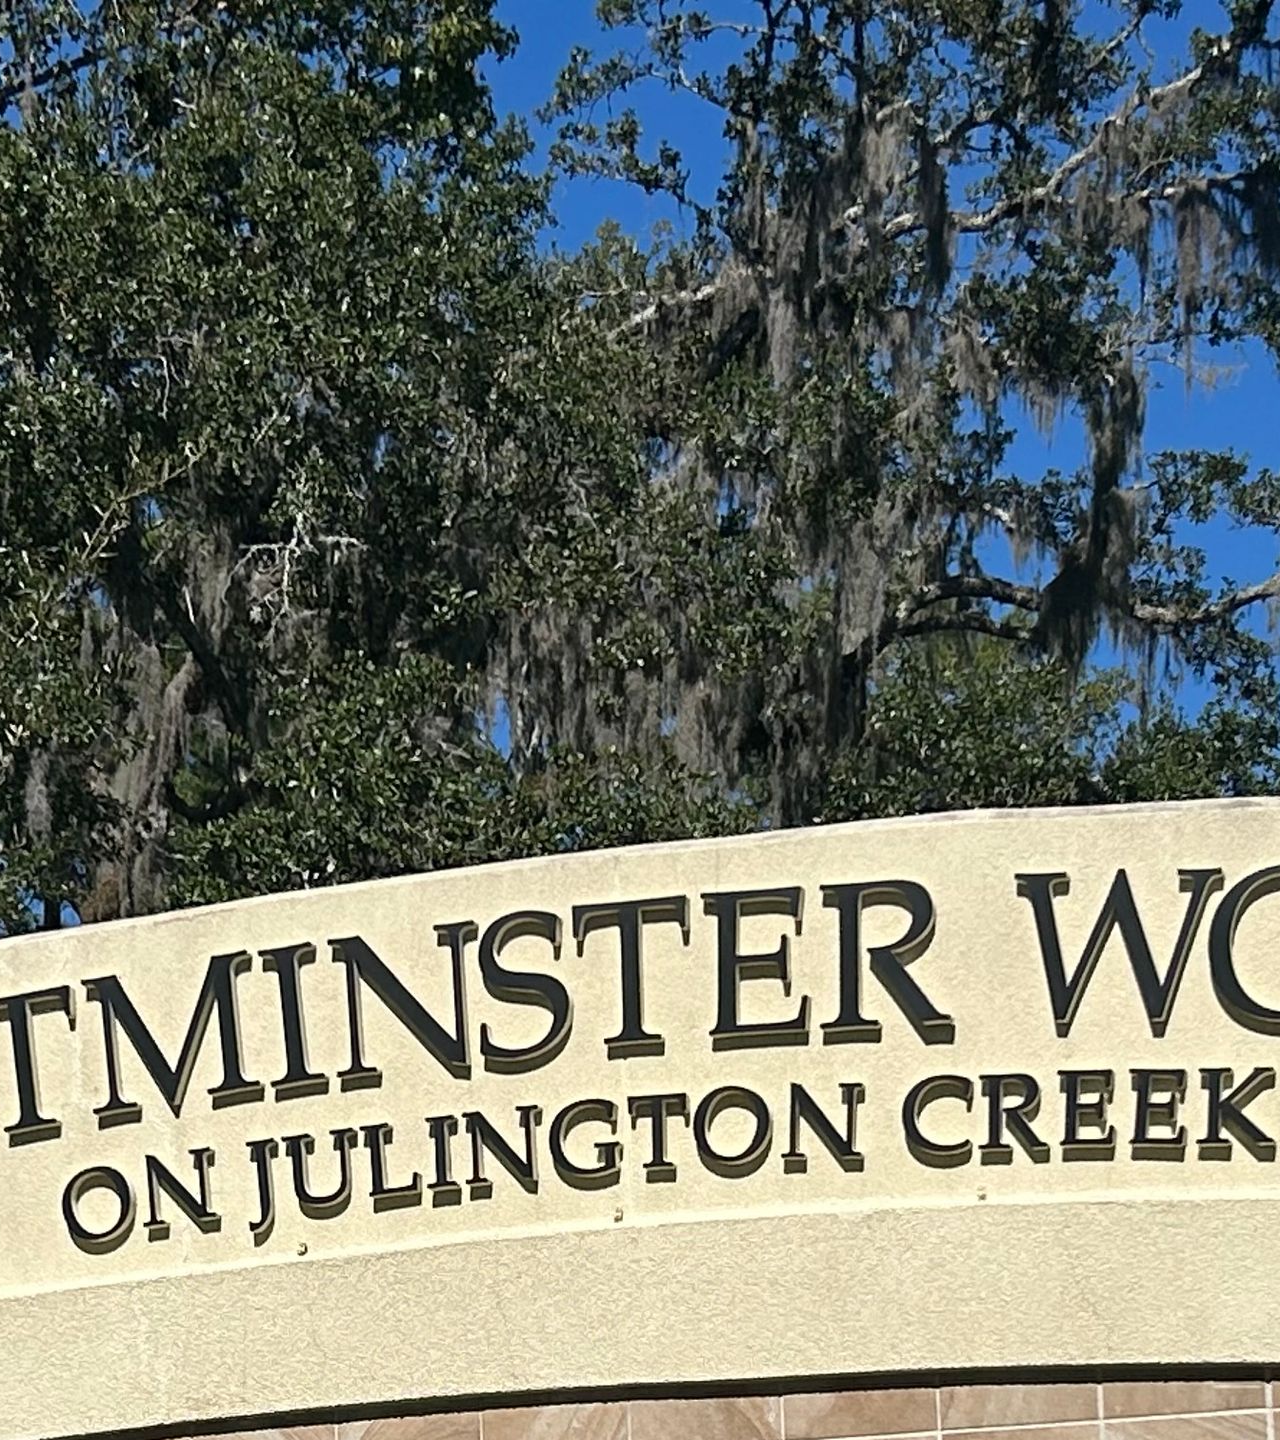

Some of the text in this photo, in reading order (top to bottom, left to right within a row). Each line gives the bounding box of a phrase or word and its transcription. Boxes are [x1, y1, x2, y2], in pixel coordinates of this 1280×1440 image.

[61, 1066, 1278, 1256] ON JULINGTON CREEK
